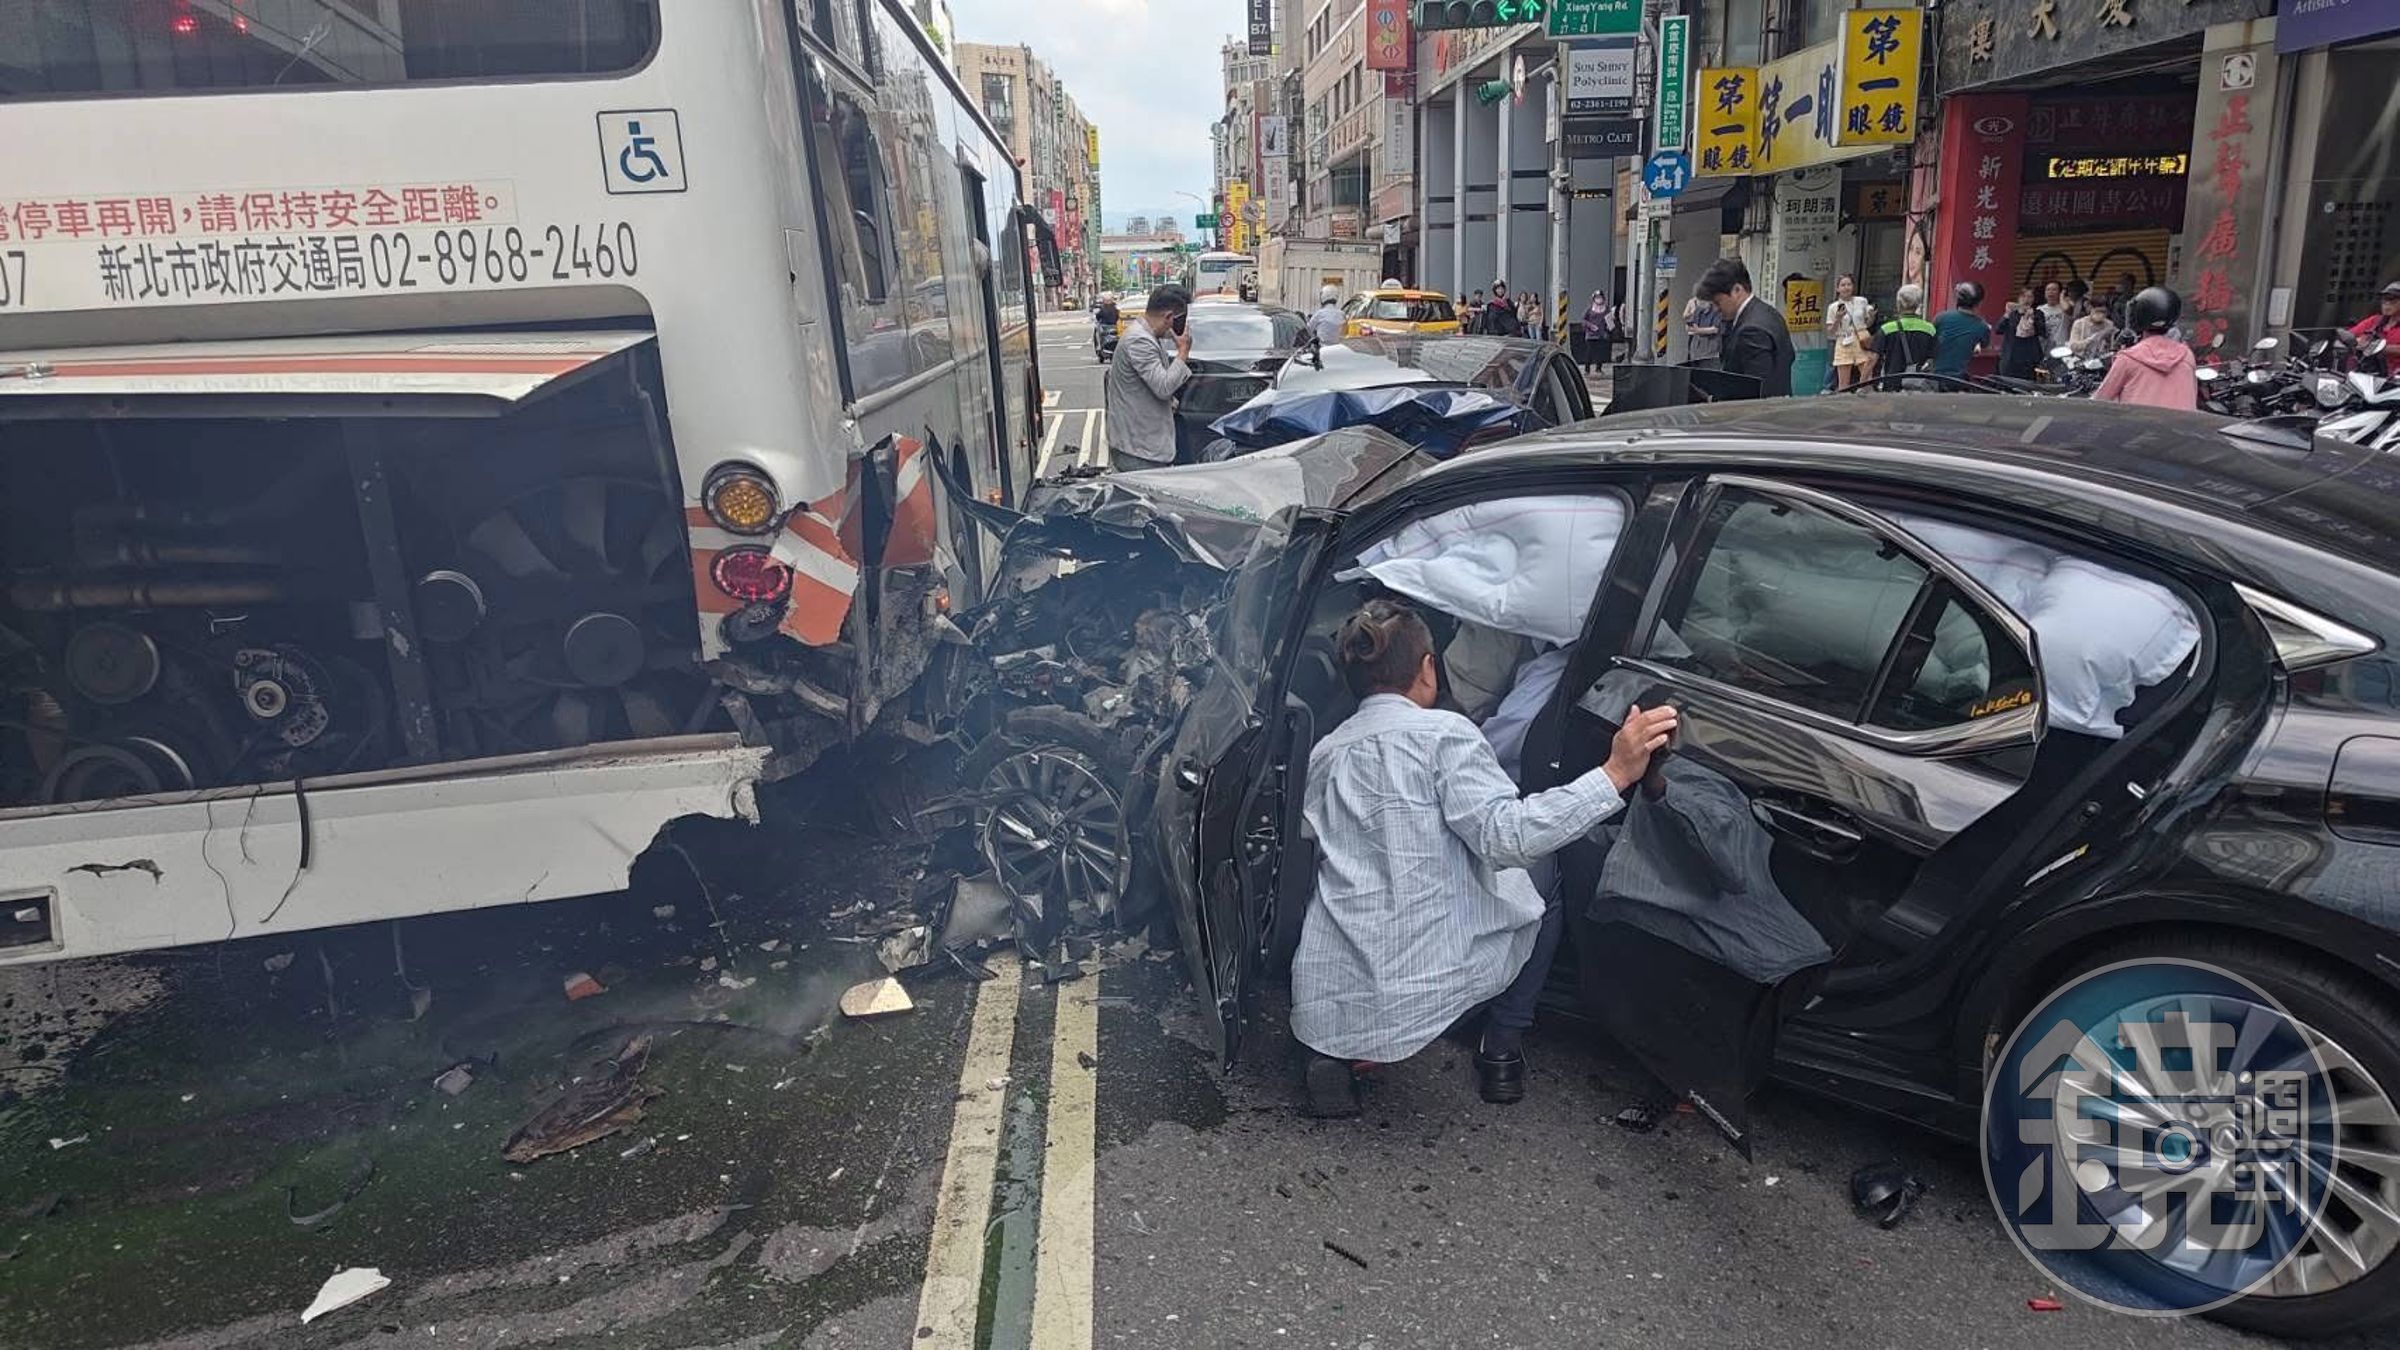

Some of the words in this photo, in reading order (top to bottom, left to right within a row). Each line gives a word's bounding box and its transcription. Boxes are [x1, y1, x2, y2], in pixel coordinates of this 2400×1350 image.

[1573, 62, 1595, 73] SUN
[1597, 61, 1630, 72] SHINY
[1573, 76, 1628, 87] Polyclinic
[1846, 102, 1908, 136] 眼鏡
[1566, 135, 1603, 144] METRO
[1607, 133, 1633, 143] CAFE
[1702, 144, 1753, 170] 眼鏡
[1969, 154, 2003, 271] 新光證券
[2022, 186, 2174, 216] 遠東圖書公司
[1791, 289, 1821, 316] 租
